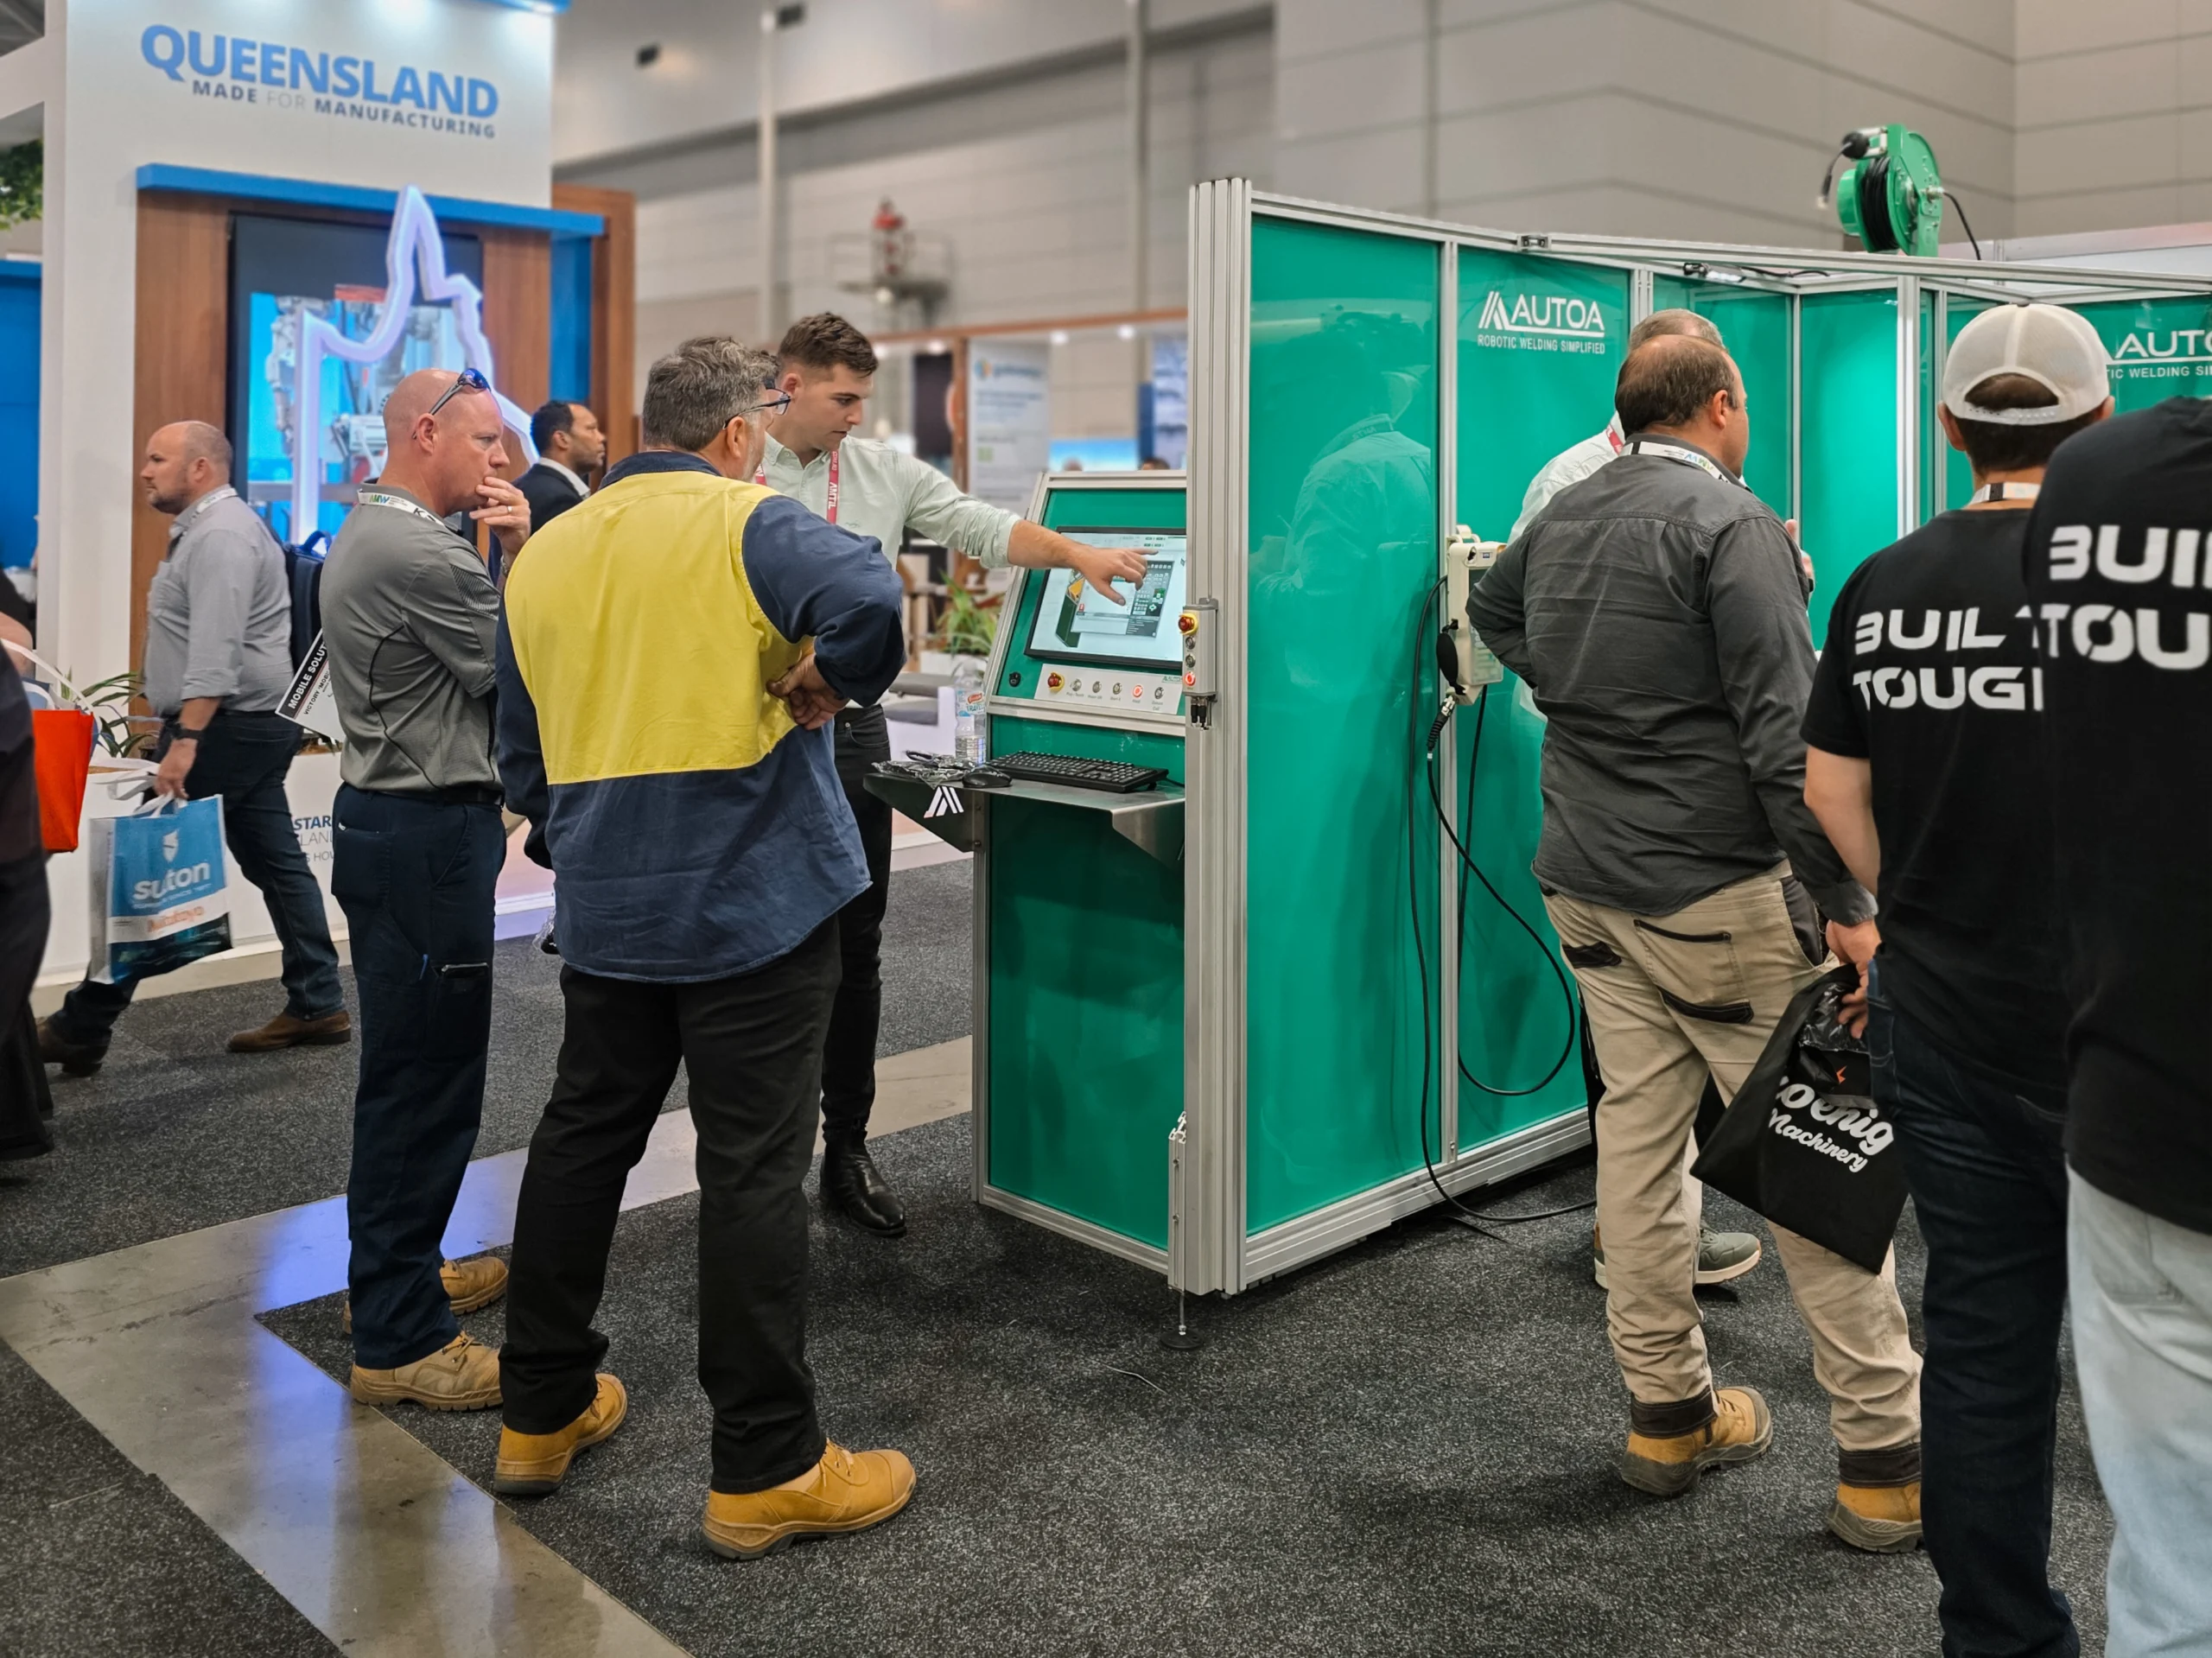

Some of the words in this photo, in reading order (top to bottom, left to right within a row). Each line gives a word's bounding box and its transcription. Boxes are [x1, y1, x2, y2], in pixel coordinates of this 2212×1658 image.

[141, 24, 499, 119] QUEENSLAND
[192, 79, 258, 105] MADE
[266, 89, 308, 111] FOR
[314, 97, 496, 139] MANUFACTURING
[1478, 334, 1516, 349] ROBOTIC
[1519, 338, 1558, 352] WELDING
[1560, 340, 1605, 354] SIMPLIFIED
[2129, 365, 2190, 378] WELDING
[287, 672, 313, 709] MOBILE
[303, 689, 321, 715] VICTORY
[1776, 1076, 1895, 1156] oenig
